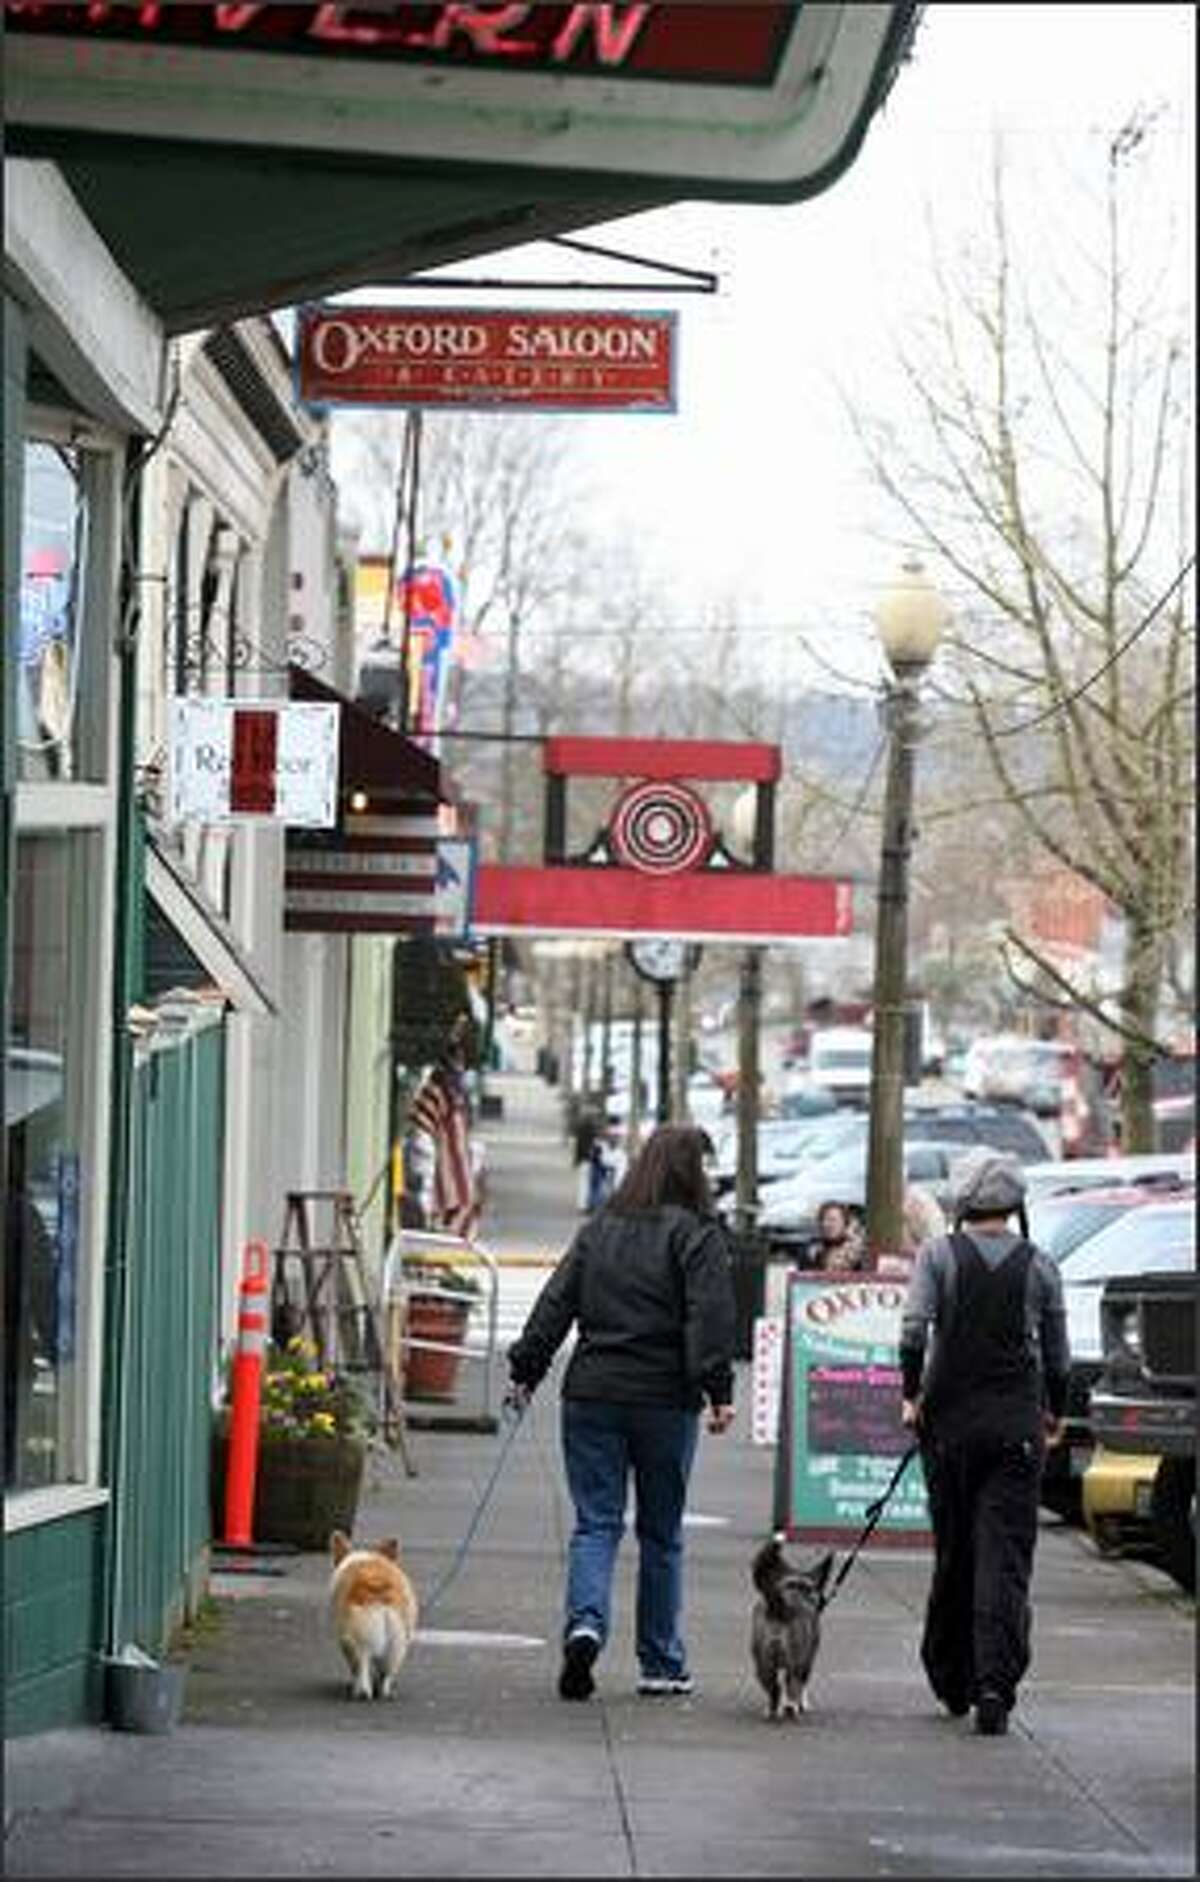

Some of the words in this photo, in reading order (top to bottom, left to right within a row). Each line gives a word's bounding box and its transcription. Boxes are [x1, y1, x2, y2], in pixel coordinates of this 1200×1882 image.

[313, 320, 488, 373] OXFORD
[506, 323, 657, 359] SALOON
[805, 1287, 903, 1327] OXFO
